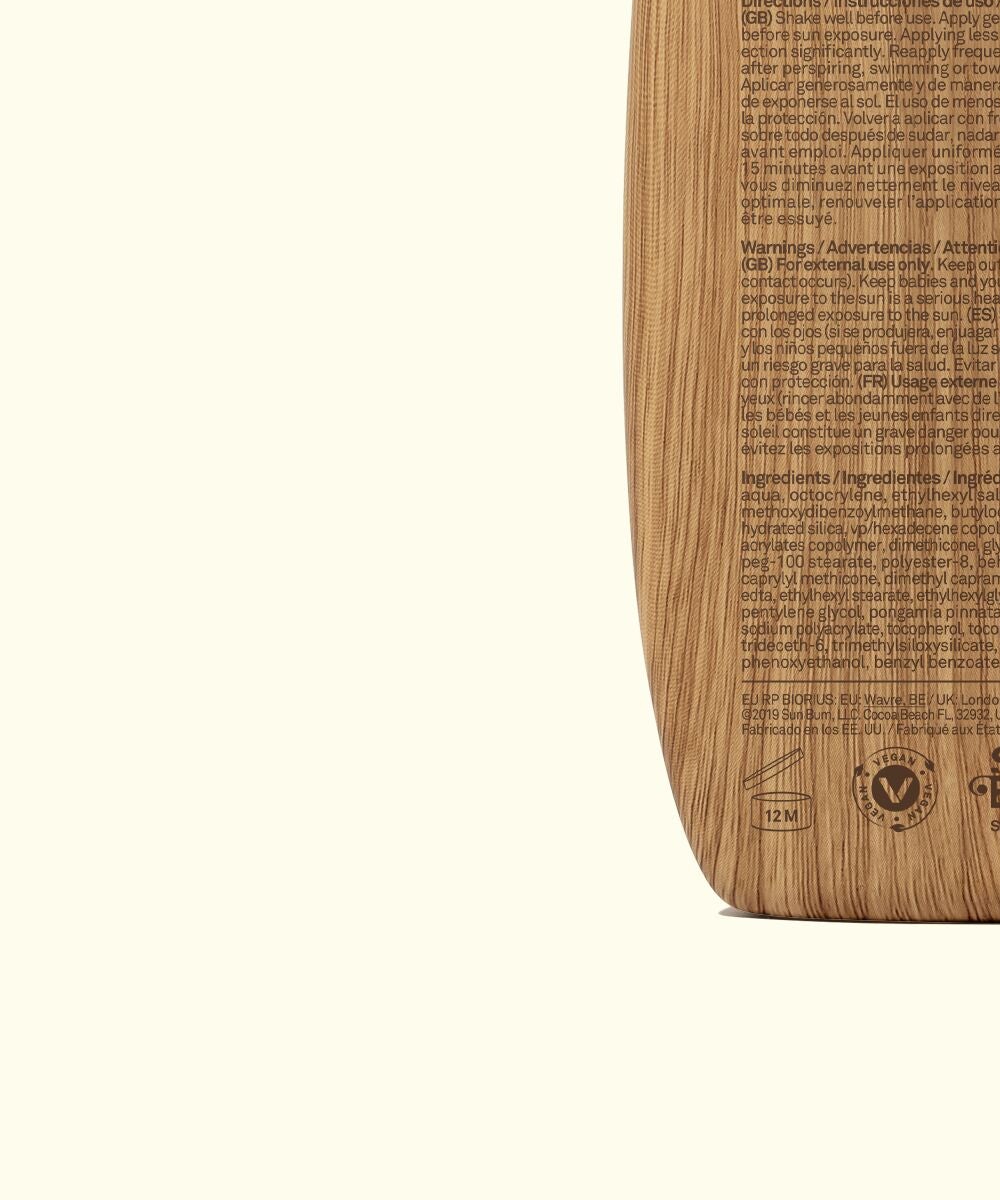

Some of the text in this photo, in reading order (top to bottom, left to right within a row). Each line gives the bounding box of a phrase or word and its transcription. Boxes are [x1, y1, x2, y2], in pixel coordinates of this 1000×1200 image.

[742, 11, 773, 27] (GB)
[775, 11, 821, 24] Shake
[824, 11, 853, 24] well
[856, 11, 903, 24] before
[906, 14, 935, 24] use.
[939, 11, 980, 28] Apply
[741, 240, 815, 258] Warnings
[826, 240, 931, 254] Advertencias
[741, 441, 785, 455] évitez
[790, 441, 810, 455] les
[814, 441, 901, 458] expositions
[905, 441, 990, 458] prolongées
[741, 470, 831, 488] Ingredients
[842, 470, 941, 488] Ingredientes
[741, 554, 804, 571] peg-100
[808, 554, 877, 570] stearate,
[881, 554, 974, 571] polyester-8,
[741, 655, 869, 672] phenoxyethanol,
[874, 655, 924, 672] benzyl
[872, 753, 917, 766] VEGAN
[859, 784, 886, 822] VEGAN
[906, 782, 933, 821] VEGAN
[765, 810, 799, 822] 12 M
